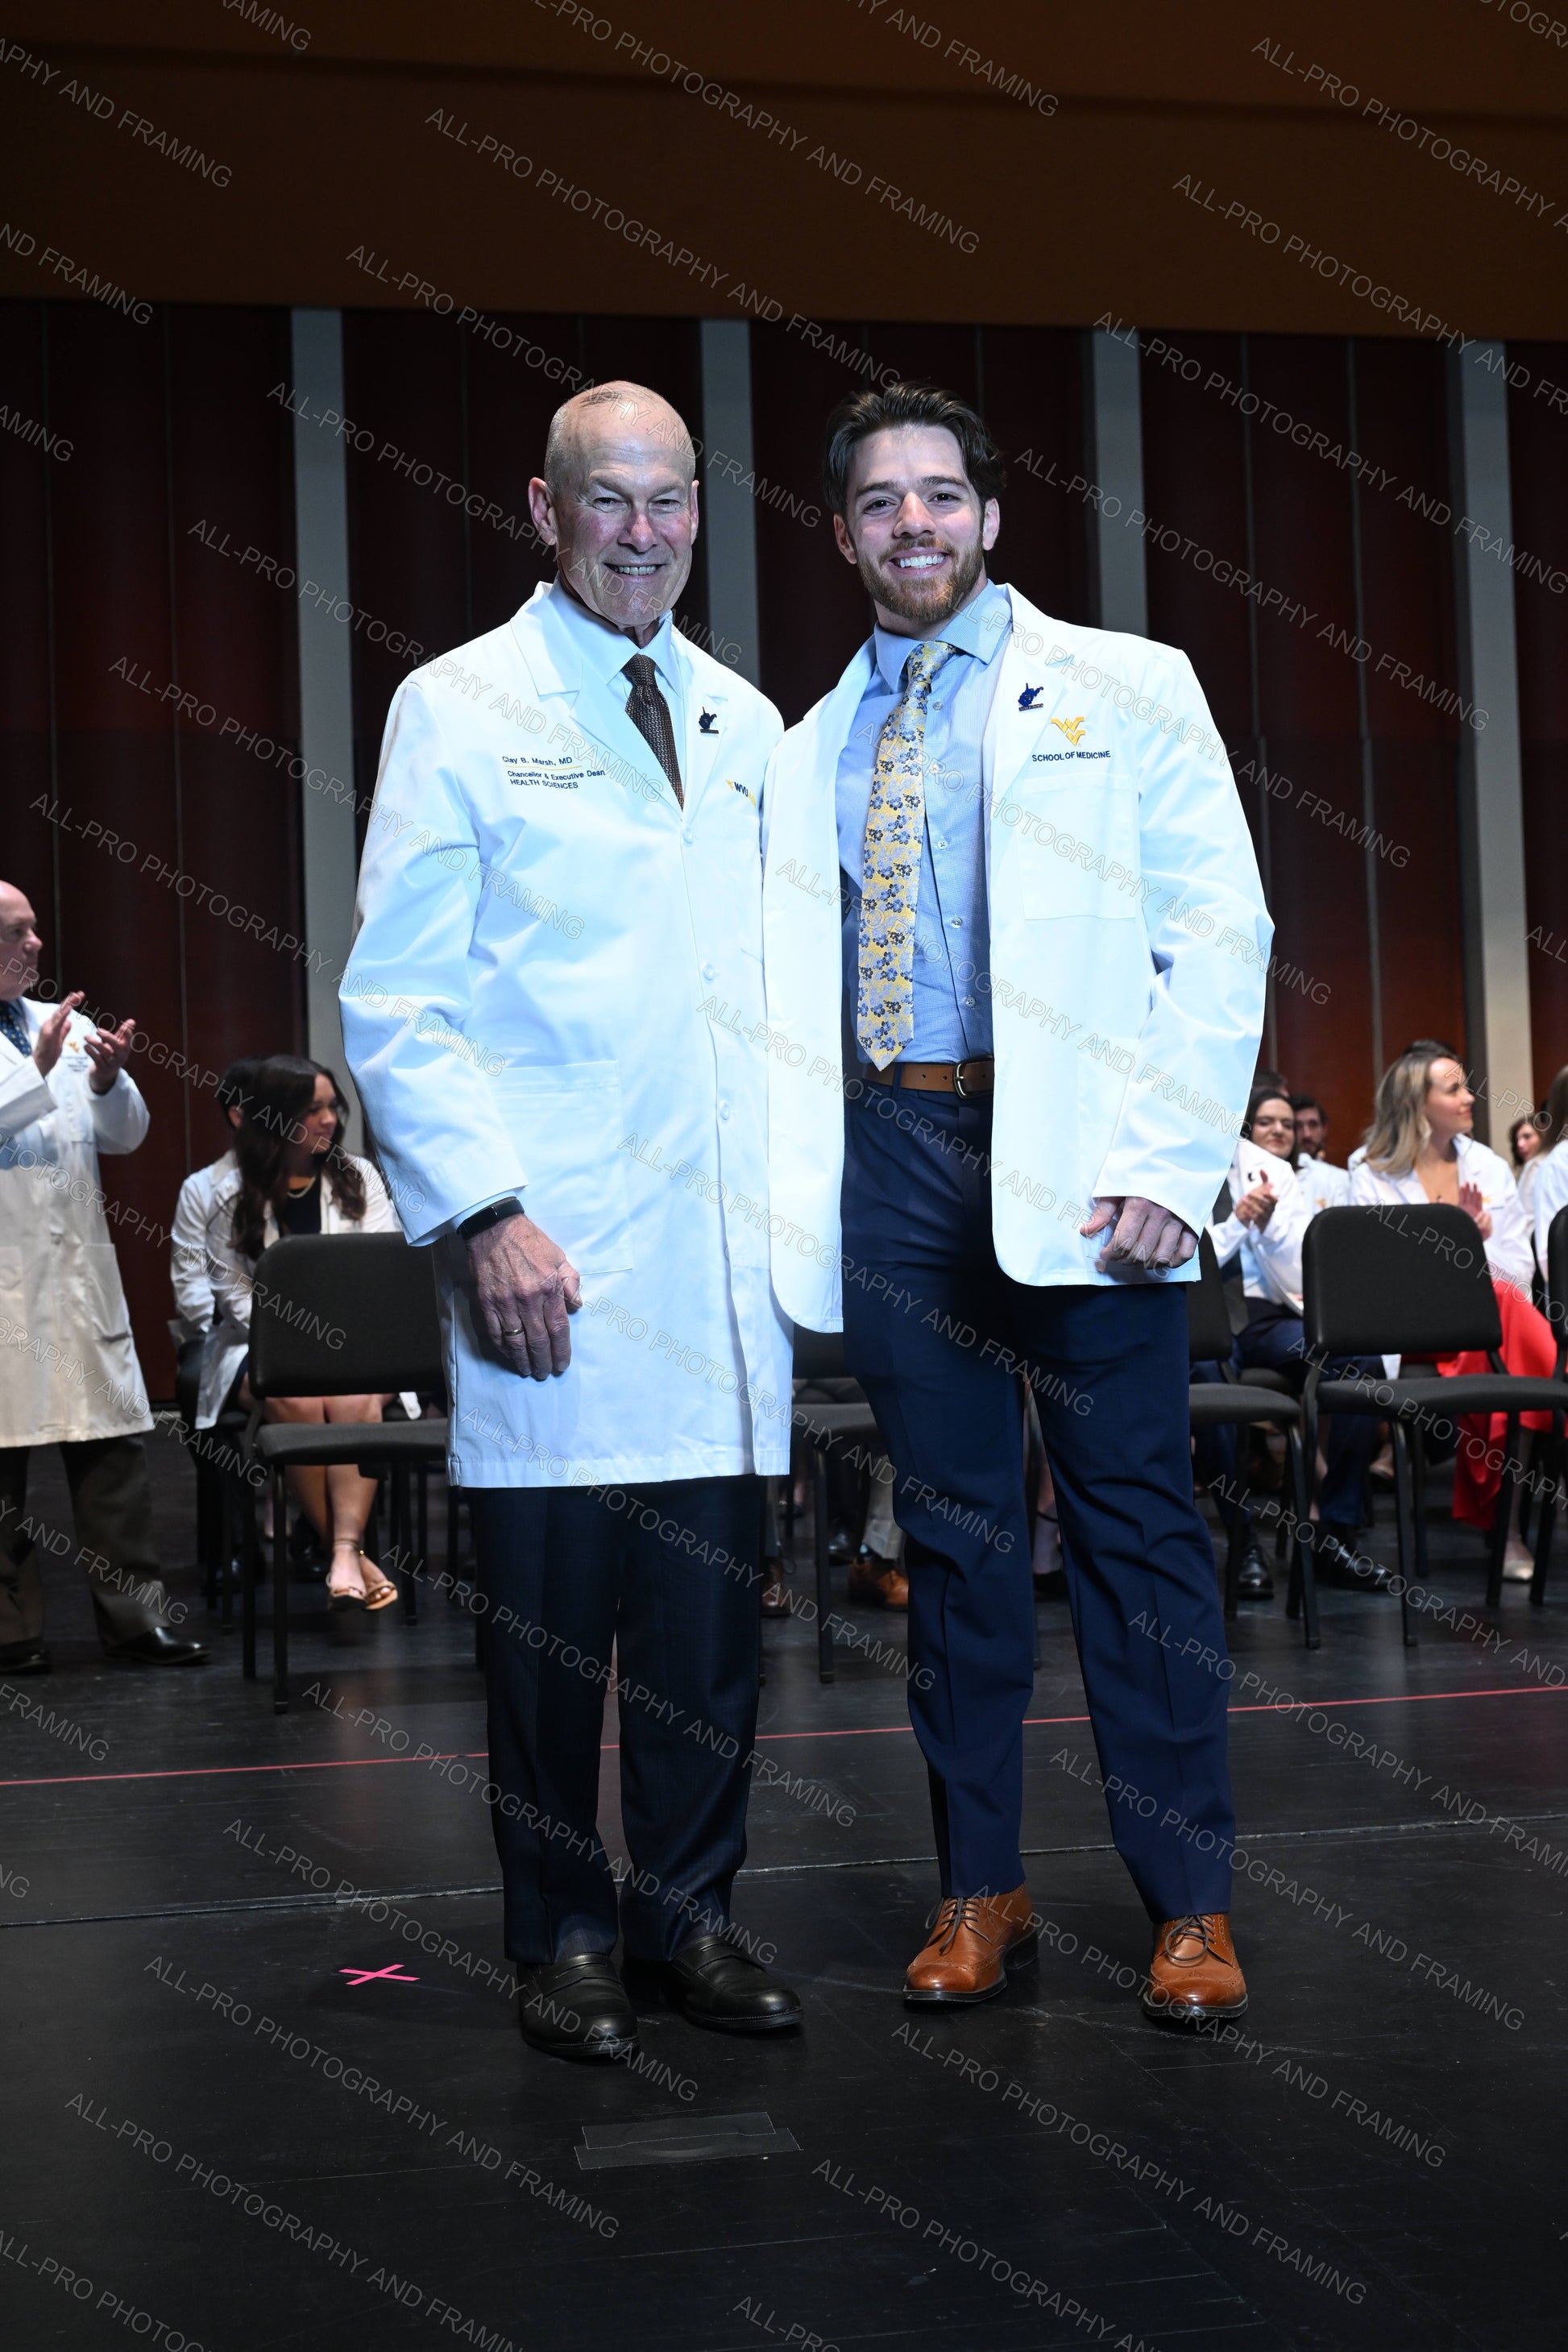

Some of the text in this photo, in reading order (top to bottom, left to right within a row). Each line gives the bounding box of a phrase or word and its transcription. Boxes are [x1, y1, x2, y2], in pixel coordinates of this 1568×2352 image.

[558, 757, 573, 765] MD
[1031, 750, 1112, 762] SCHOOL OF MEDICINE
[551, 771, 584, 781] Executive
[587, 769, 606, 778] Dean
[510, 778, 579, 790] HEALTH SCIENCES
